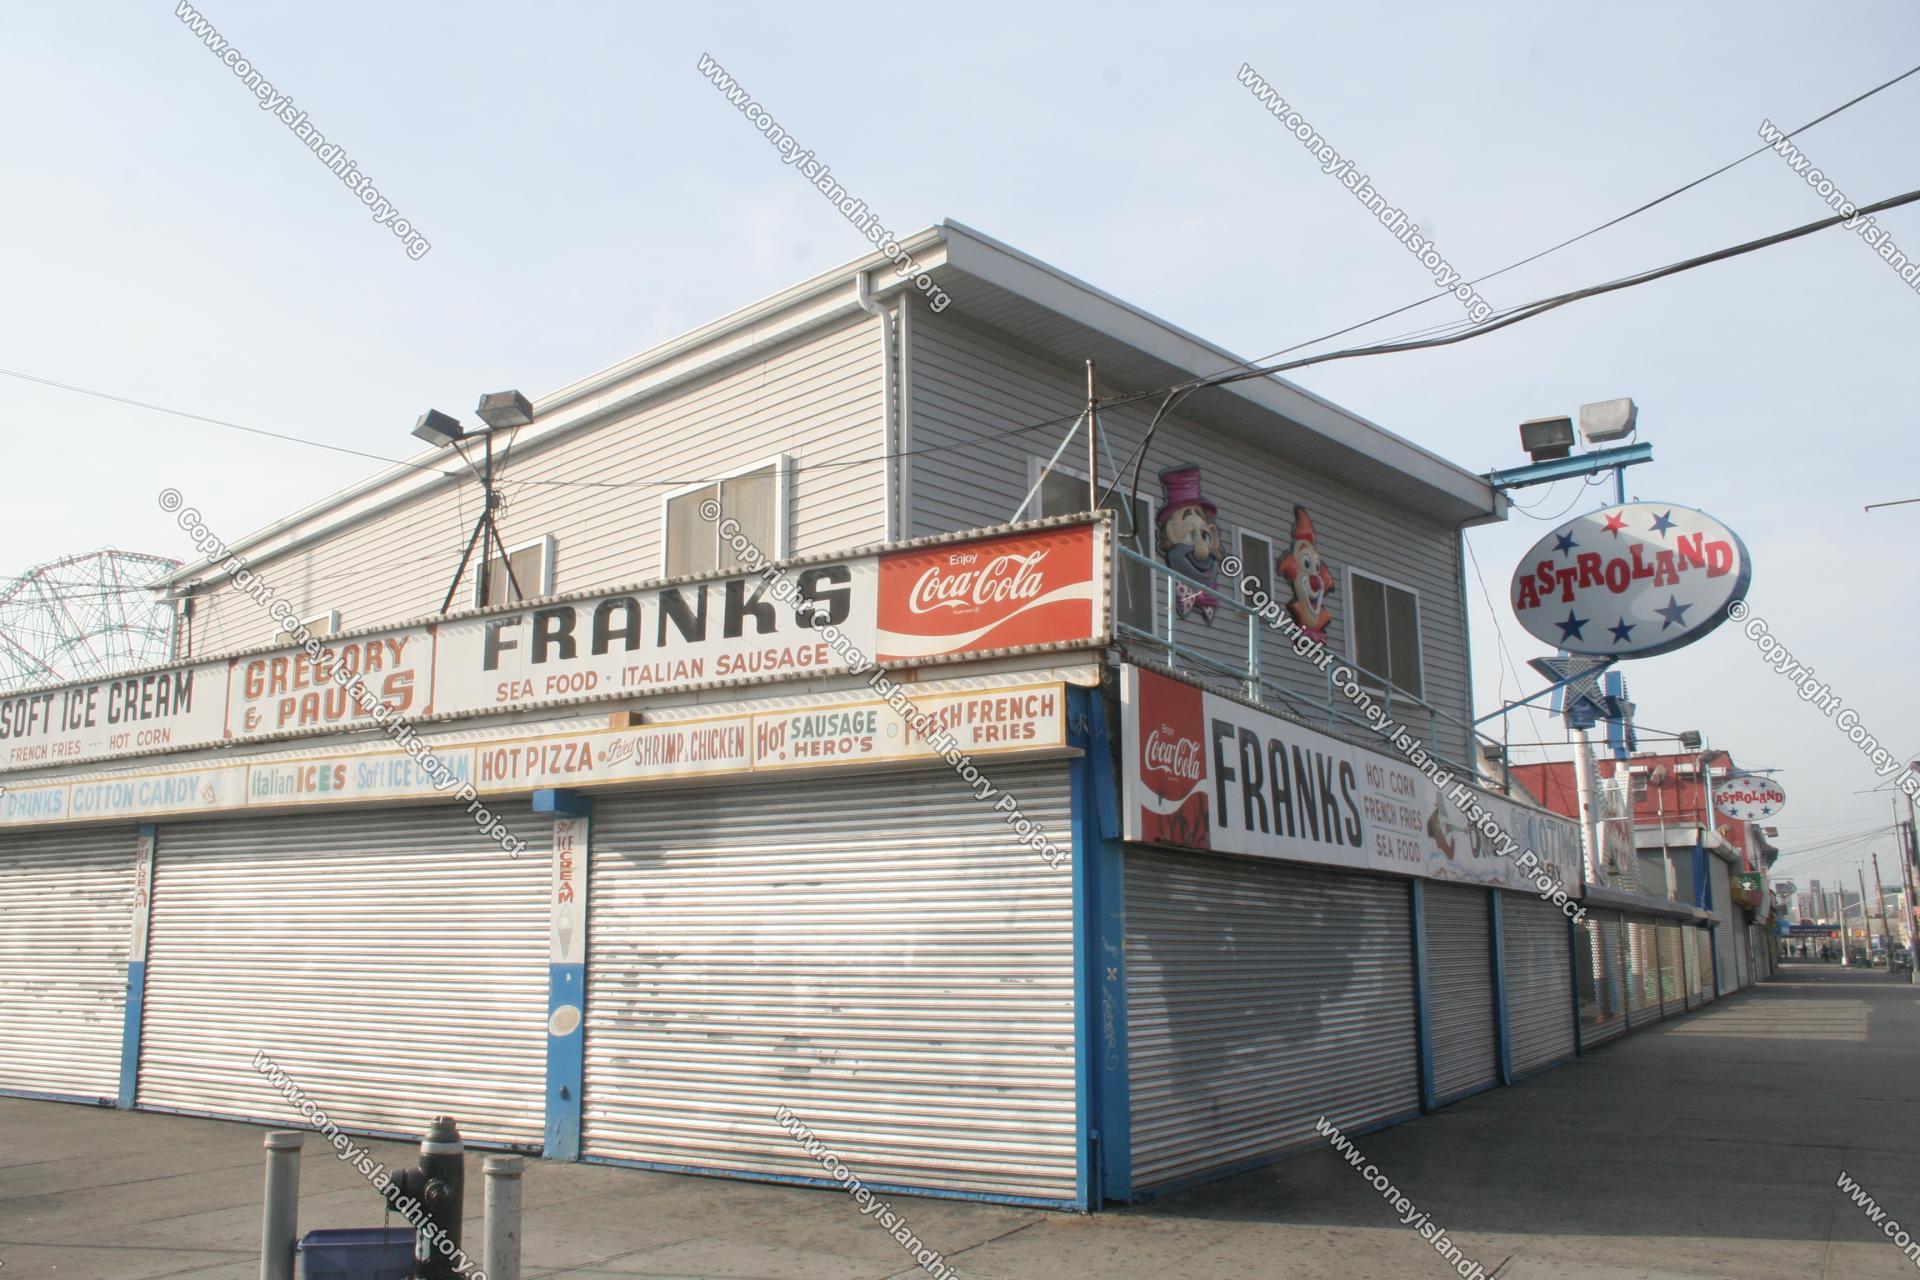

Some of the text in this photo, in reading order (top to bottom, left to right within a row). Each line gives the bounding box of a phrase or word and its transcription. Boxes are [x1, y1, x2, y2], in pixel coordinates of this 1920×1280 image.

[949, 553, 978, 566] Enjoy
[1517, 532, 1734, 610] ASTROLAND
[909, 549, 1051, 614] Coca-Cola
[483, 565, 851, 671] FRANKS
[244, 636, 410, 702] GREGORY
[496, 643, 829, 702] SEA FOOD ITALIAN SAUSAGE
[0, 669, 194, 739] SOFT ICE CREAM
[244, 706, 263, 732] &
[967, 694, 1054, 724] FRENCH
[791, 710, 877, 739] SAUSAGE
[973, 722, 1036, 743] FRIES
[10, 728, 171, 761] FRENCH FRIES HOT CORN
[482, 742, 593, 781] HOT PIZZA
[606, 737, 637, 767] Fried
[635, 732, 684, 766] SHRIMP
[690, 725, 745, 762] CHICKEN
[795, 736, 873, 757] HERO'S
[1145, 730, 1200, 780] Coca-Cola
[252, 764, 347, 797] Italian ICES
[358, 754, 469, 789] Soft ICE CAM
[1211, 718, 1363, 848] FRANKS
[1365, 762, 1415, 798] HOT CORN
[8, 790, 63, 816] DRINKS
[72, 776, 200, 814] COTTON CANDY
[1716, 790, 1783, 805] ASTROLAND
[1364, 796, 1422, 832] FRENCH FRIES
[557, 835, 574, 851] ICE
[1376, 832, 1420, 863] SEA FOOD
[558, 851, 574, 904] CREAM
